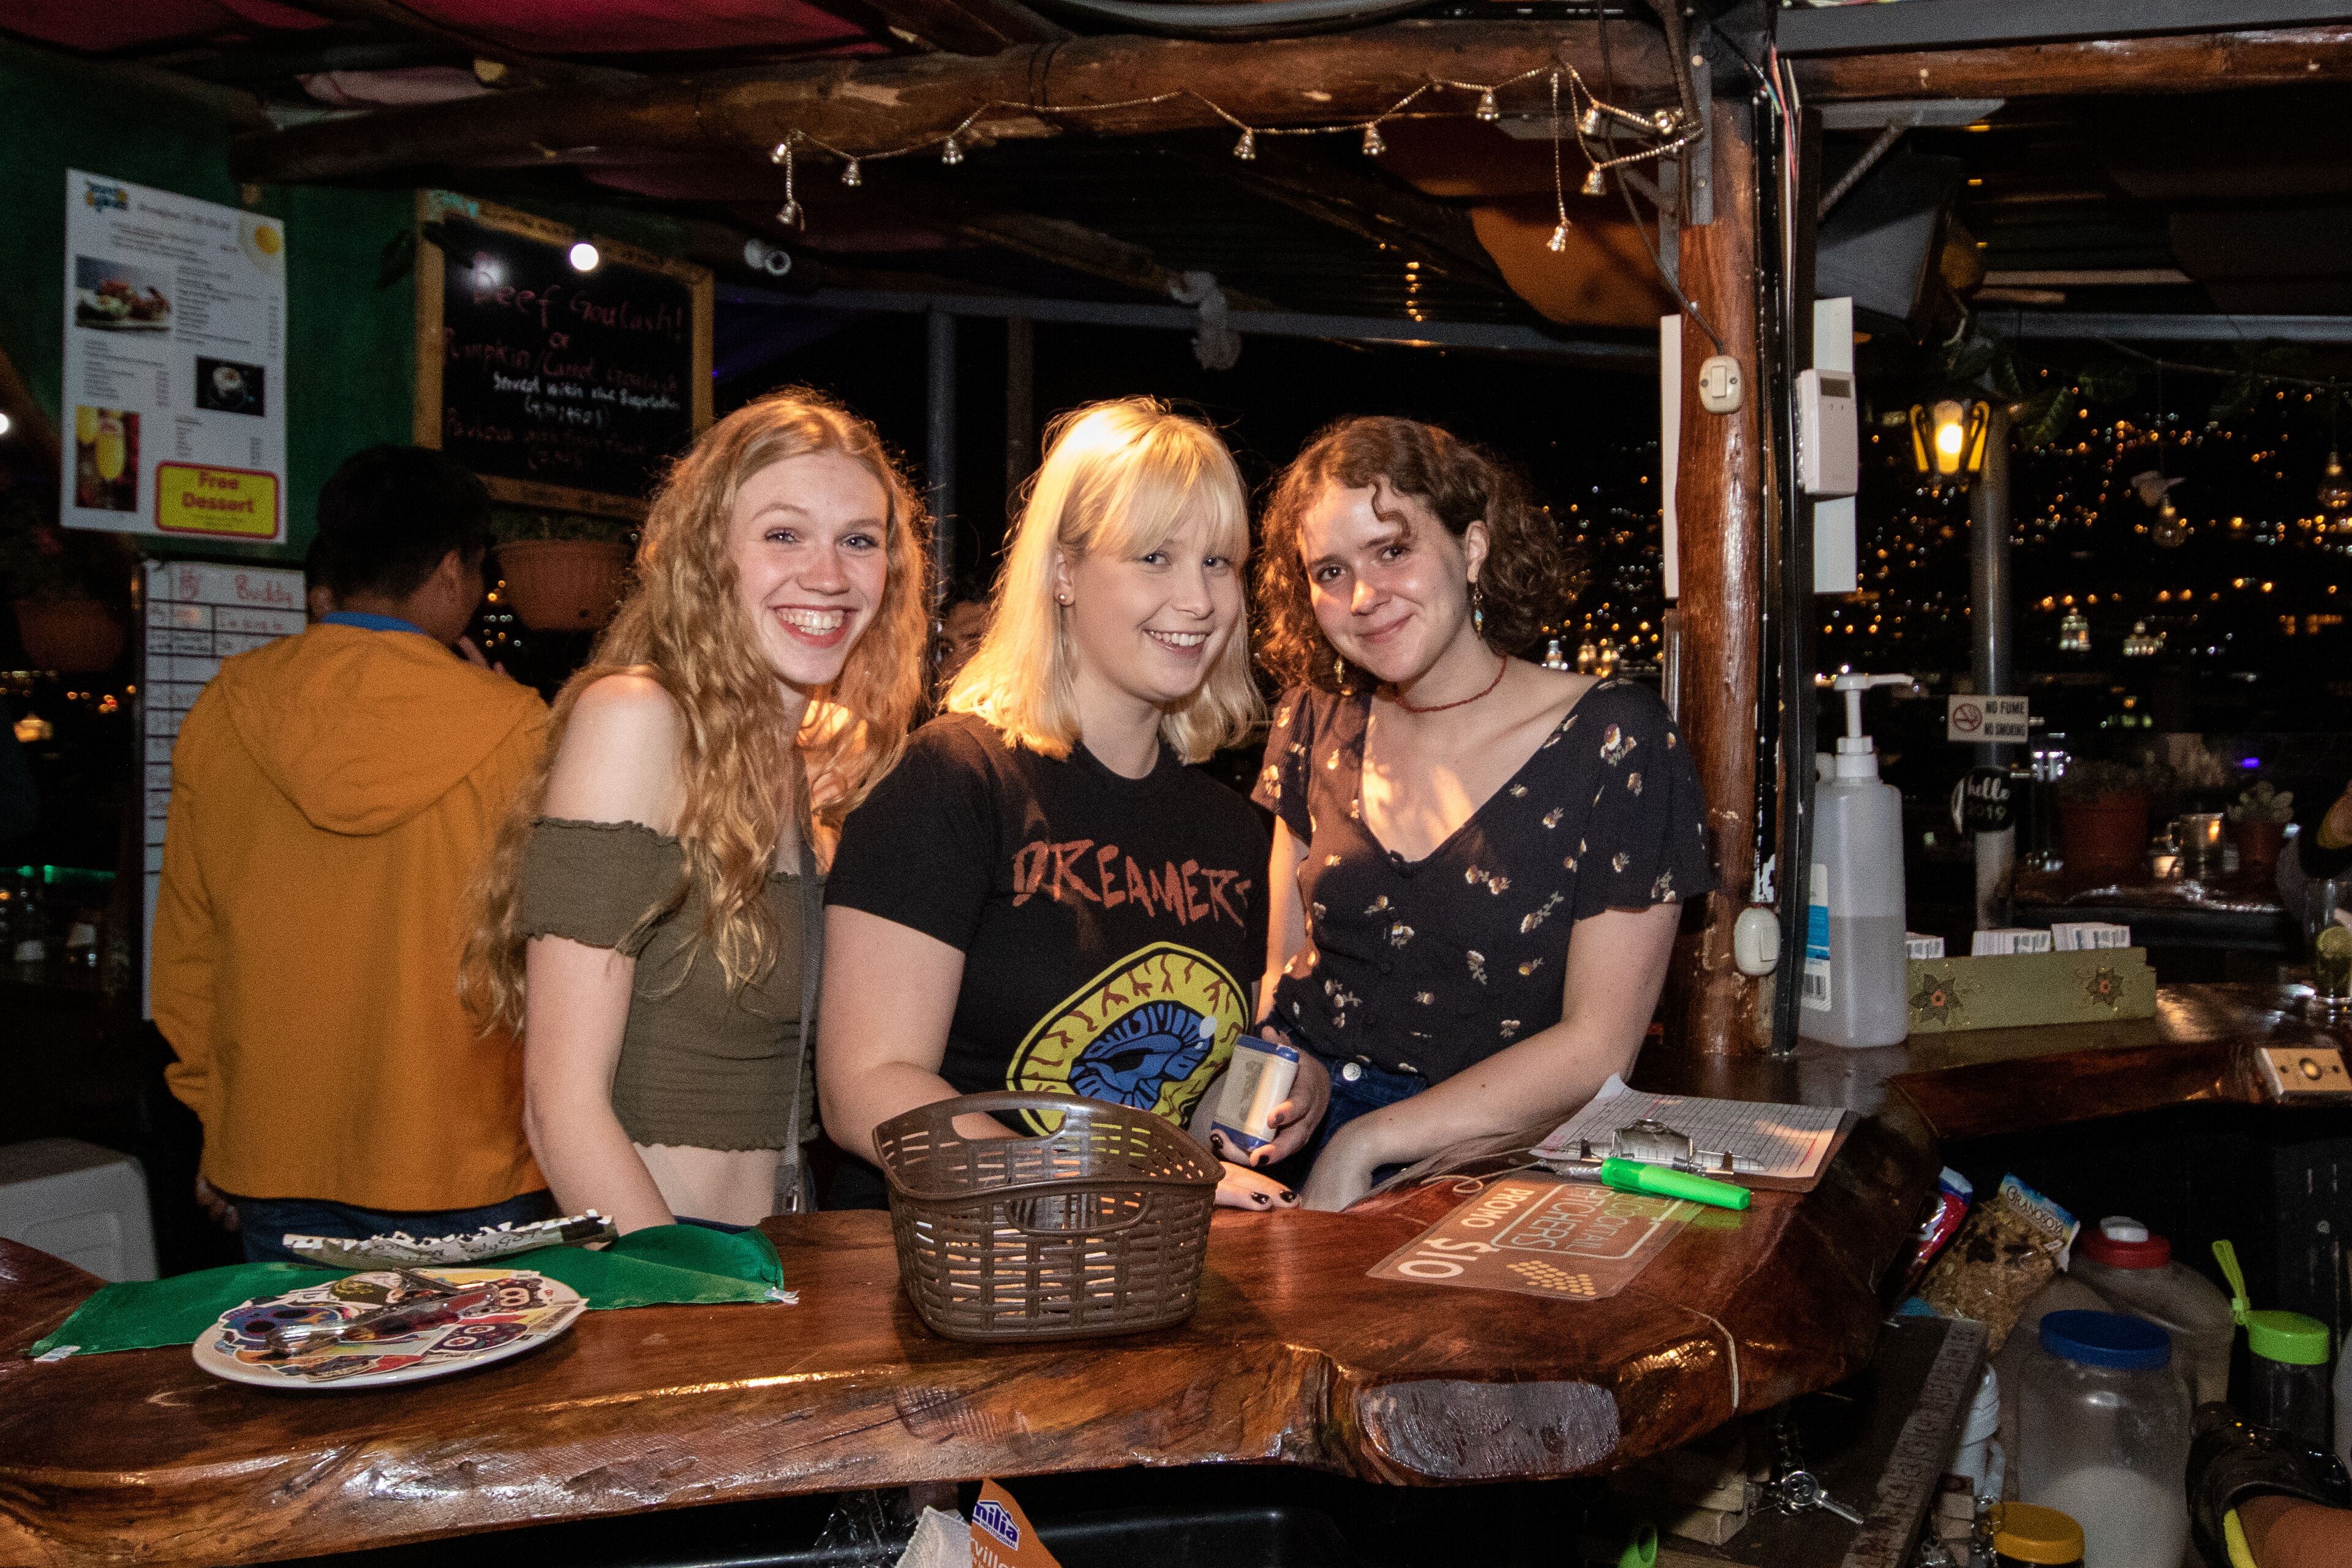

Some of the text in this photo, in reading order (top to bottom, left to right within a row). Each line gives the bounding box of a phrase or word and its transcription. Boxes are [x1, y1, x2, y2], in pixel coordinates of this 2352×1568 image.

[200, 470, 239, 489] Free
[183, 492, 254, 513] Dessert
[1461, 1188, 1536, 1227] PROMO
[1511, 1186, 1616, 1248] PITCHERS
[1398, 1238, 1501, 1278] $10
[981, 1521, 1016, 1549] INSTITUCIONAL
